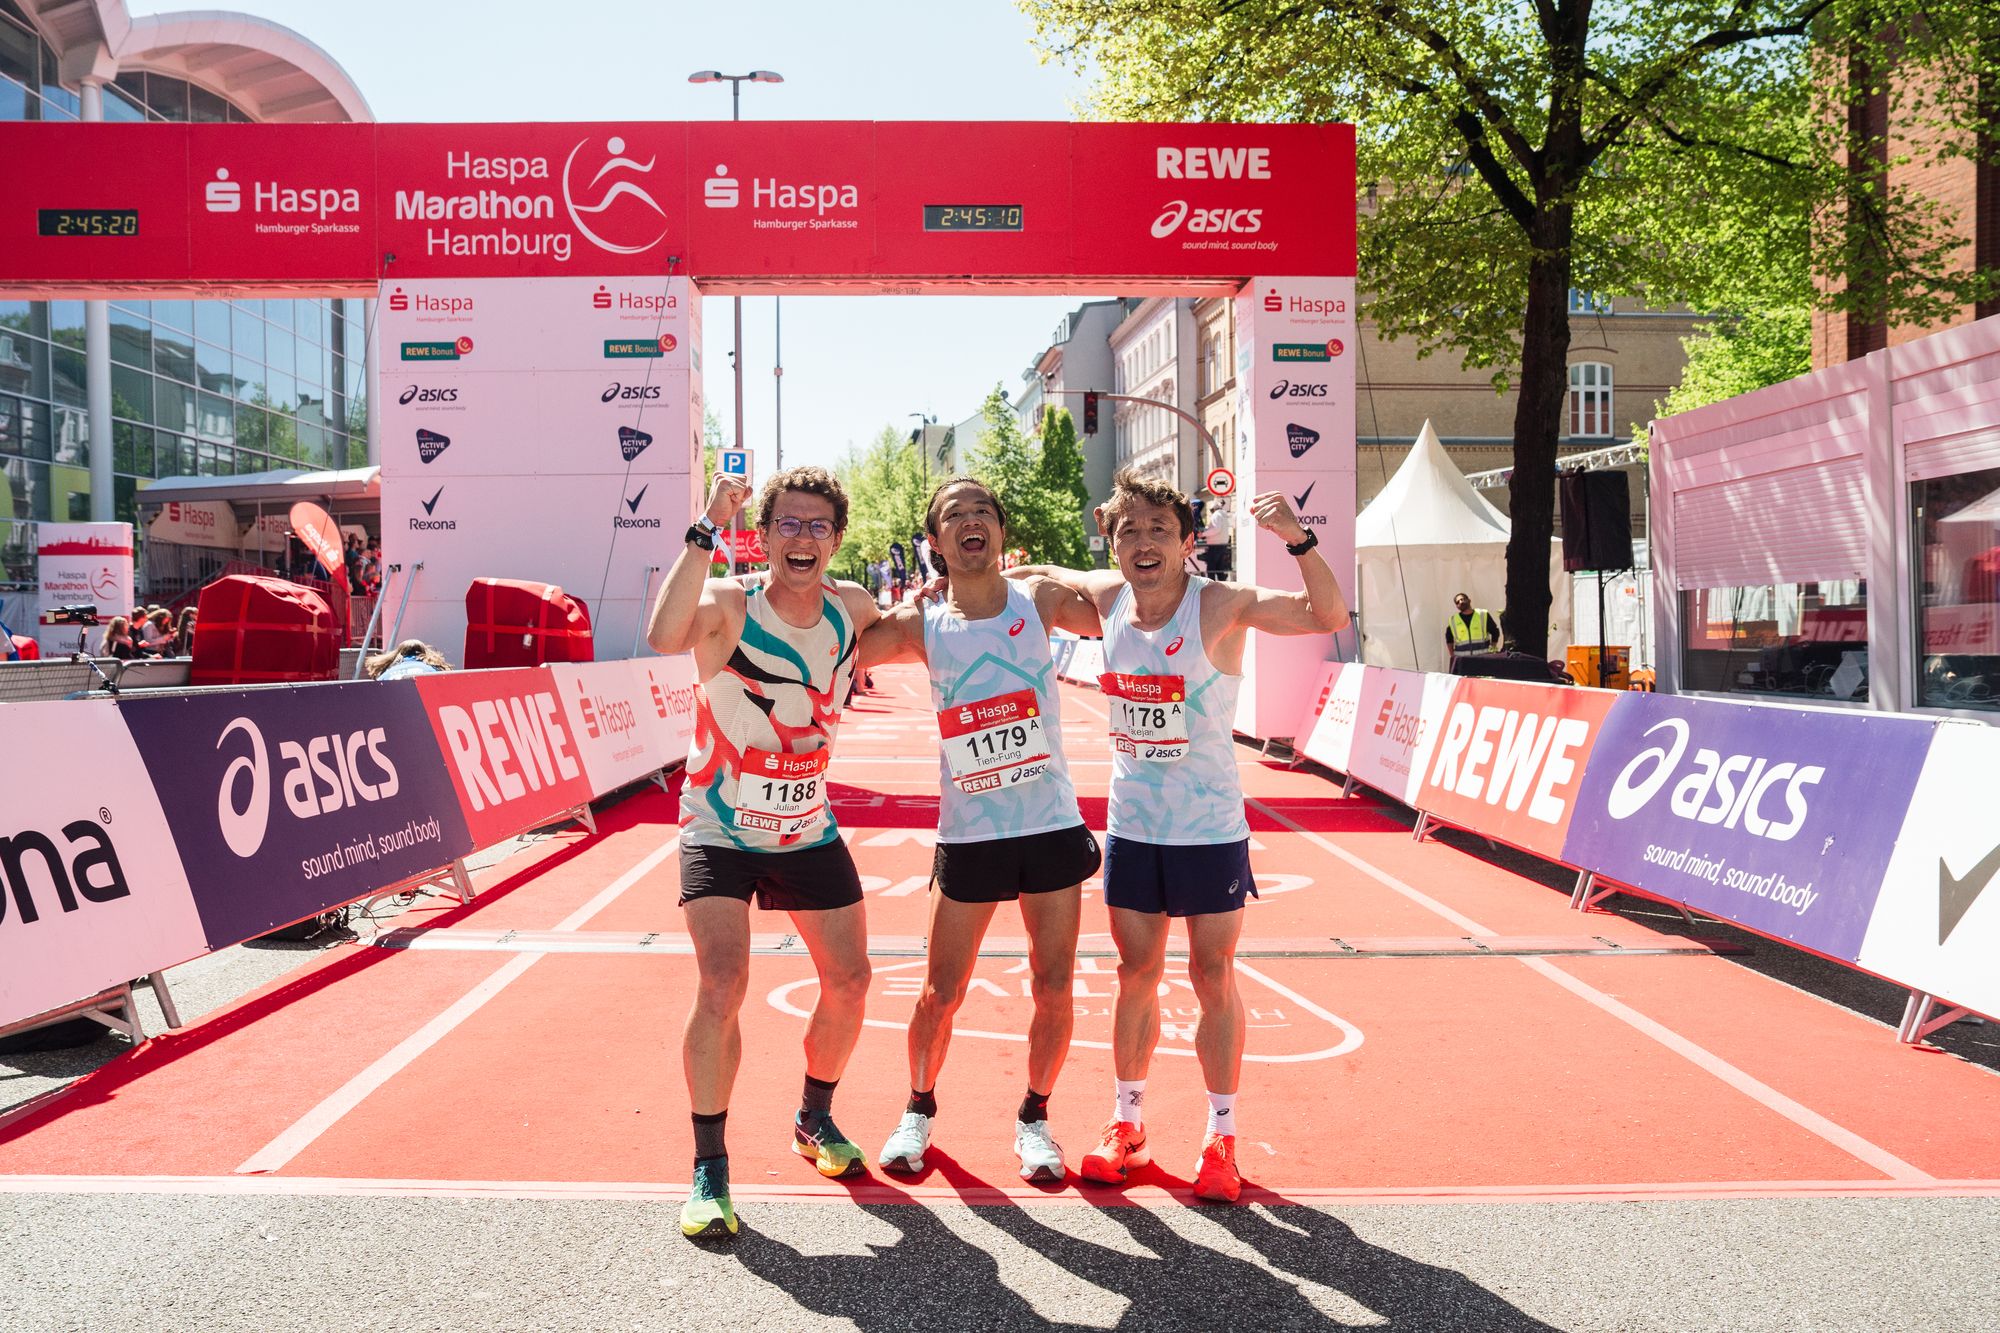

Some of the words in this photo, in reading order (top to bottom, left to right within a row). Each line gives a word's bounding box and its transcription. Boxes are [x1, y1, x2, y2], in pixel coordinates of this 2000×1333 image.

[447, 151, 549, 185] Haspa
[1157, 147, 1271, 180] REWE
[255, 181, 360, 220] Haspa
[395, 190, 554, 220] Marathon
[754, 178, 858, 216] Haspa
[57, 216, 137, 235] 2:45:20
[754, 218, 807, 230] Hamburger
[809, 218, 858, 230] Sparkasse
[941, 208, 1019, 226] 2:45:10
[1187, 208, 1263, 233] asics
[255, 223, 309, 235] Hamburger
[311, 223, 360, 234] Sparkasse
[427, 228, 572, 262] Hamburg
[1182, 241, 1208, 251] sound
[1208, 241, 1230, 251] mind,
[1231, 241, 1257, 251] sound
[1257, 241, 1279, 252] body
[416, 294, 473, 315] Haspa
[620, 292, 677, 312] Haspa
[1290, 296, 1345, 316] Haspa
[406, 348, 430, 356] REWE
[431, 347, 454, 356] Bonus
[609, 345, 633, 353] REWE
[1278, 349, 1301, 357] REWE
[1303, 349, 1325, 357] Bonus
[418, 389, 458, 402] asics
[1289, 384, 1327, 397] asics
[728, 455, 741, 472] P
[184, 503, 215, 527] Haspa
[410, 518, 457, 530] Rexona
[614, 516, 661, 529] Rexona
[52, 593, 94, 602] Hamburg
[1126, 680, 1162, 696] Haspa
[977, 702, 1017, 719] Haspa
[1172, 703, 1181, 714] A
[595, 695, 636, 741] Haspa
[967, 726, 1027, 758] 1179
[1030, 719, 1039, 730] A
[1386, 702, 1427, 757] Haspa
[439, 691, 580, 812] REWE
[976, 751, 1022, 767] Tien-Fung
[1156, 748, 1181, 758] asics
[783, 759, 819, 772] Haspa
[1430, 702, 1589, 825] REWE
[279, 727, 399, 819] asics
[762, 780, 817, 803] 1188
[963, 777, 1001, 793] REWE
[1670, 748, 1826, 841] asics
[774, 803, 800, 812] Julian
[743, 814, 780, 831] REWE
[302, 844, 344, 880] sound
[346, 834, 380, 867] mind,
[378, 823, 415, 855] sound
[415, 816, 441, 844] body
[1643, 844, 1690, 872] sound
[1689, 853, 1725, 886] mind,
[1723, 868, 1777, 896] sound
[1771, 875, 1819, 916] body
